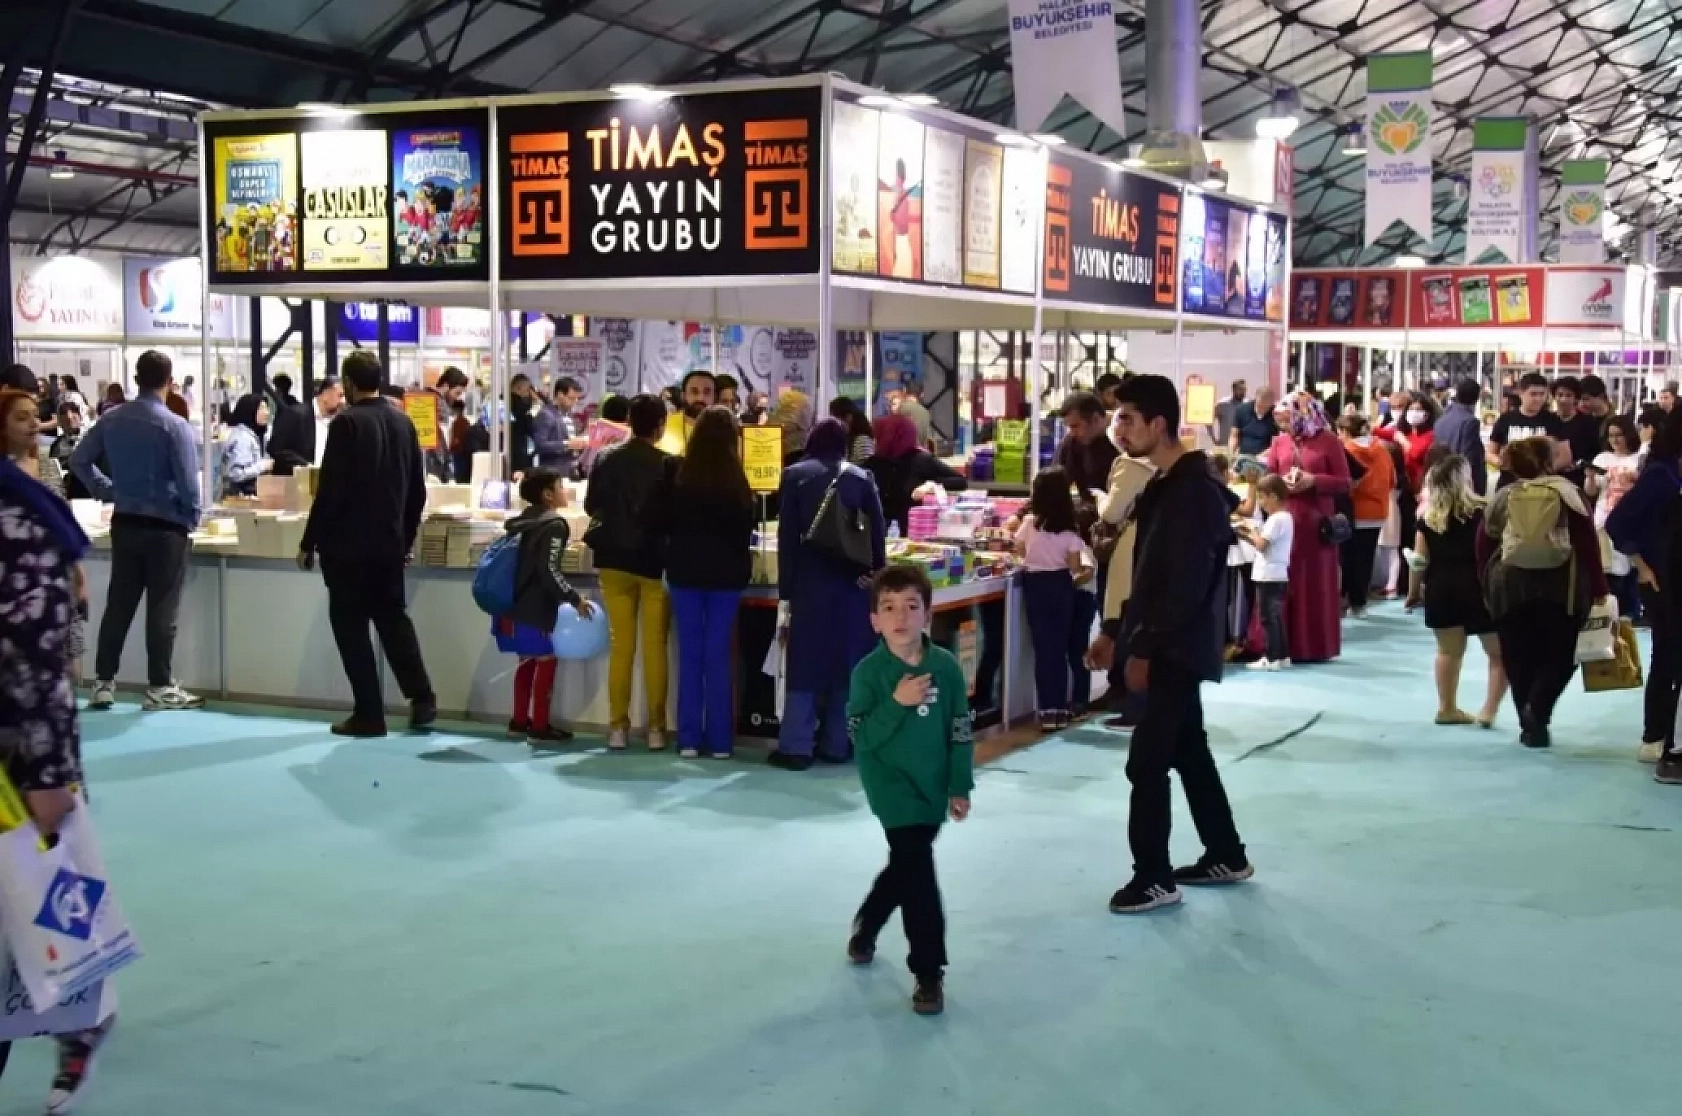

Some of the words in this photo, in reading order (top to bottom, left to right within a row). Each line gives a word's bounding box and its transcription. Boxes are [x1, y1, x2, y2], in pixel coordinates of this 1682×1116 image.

[586, 117, 727, 177] TİMAŞ
[744, 142, 808, 168] TİMAŞ
[511, 153, 570, 180] TİMAŞ
[590, 179, 722, 215] YAYIN
[591, 218, 722, 252] GRUBU
[1091, 186, 1140, 253] TİMAŞ
[1072, 244, 1110, 280] YAYIN
[1112, 252, 1153, 286] GRUBU
